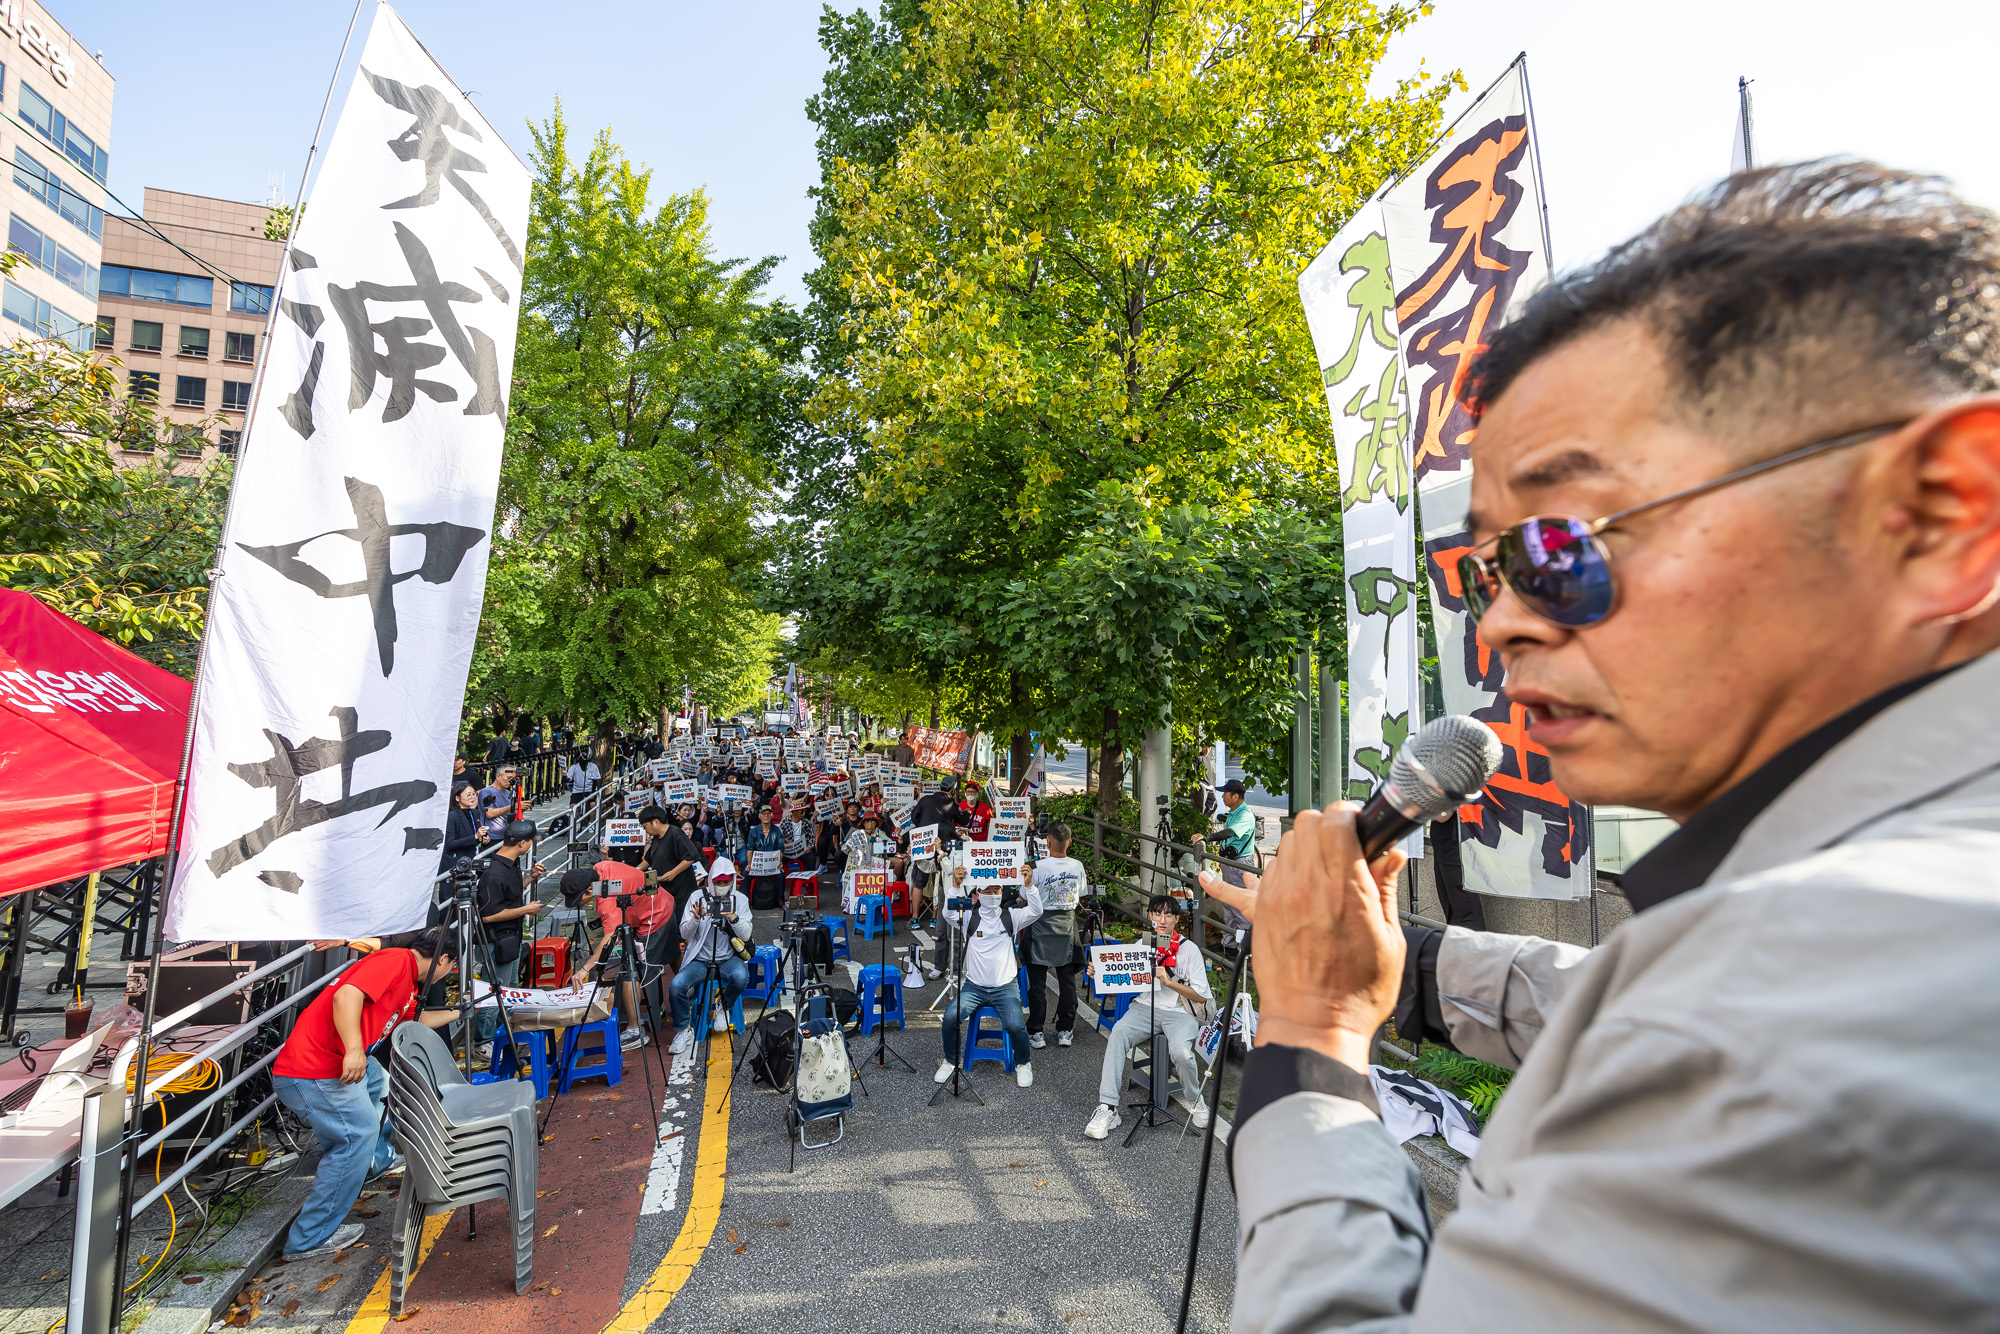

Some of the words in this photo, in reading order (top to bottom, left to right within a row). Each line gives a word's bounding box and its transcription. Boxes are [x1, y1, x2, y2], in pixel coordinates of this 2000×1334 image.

[205, 64, 524, 894] 天滅中共
[970, 848, 993, 858] 중국인
[994, 848, 1017, 857] 관광객
[975, 857, 1013, 866] 3000만명
[970, 867, 998, 879] 무비자
[998, 867, 1017, 879] 반대
[857, 875, 885, 885] OUT
[1099, 951, 1123, 963] 중국인
[1124, 950, 1148, 961] 관광객
[1105, 961, 1145, 971] 3000만명
[1102, 973, 1131, 986] 무비자
[1131, 972, 1152, 986] 반대
